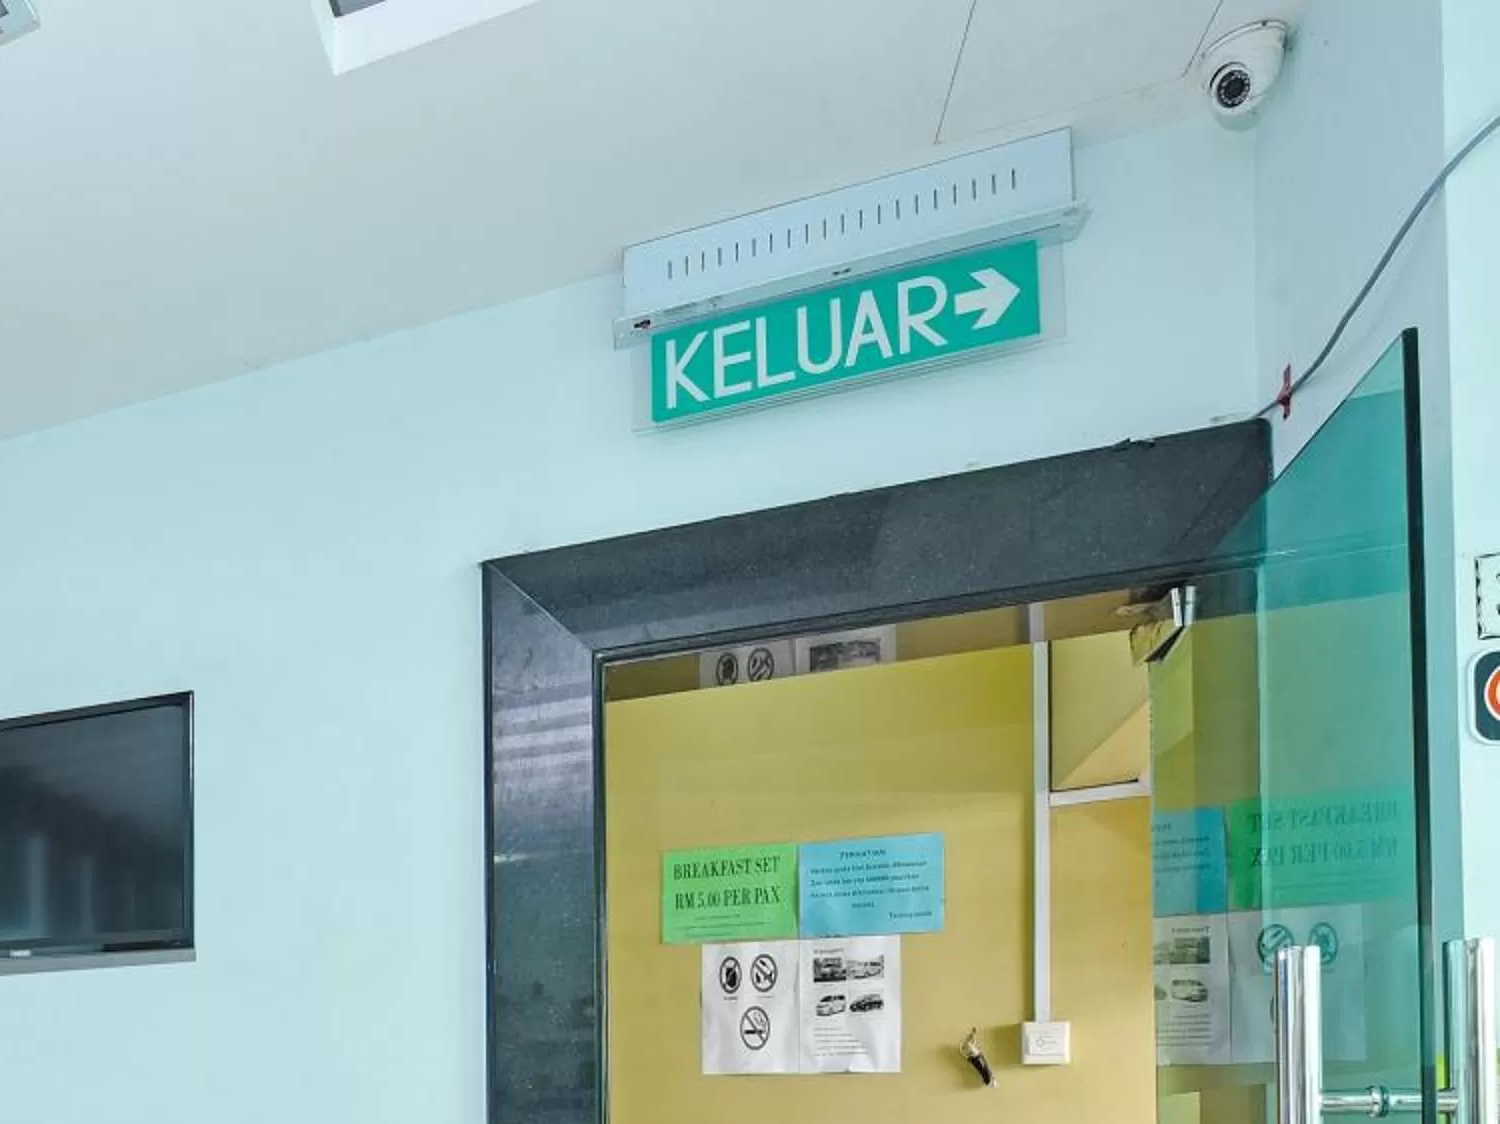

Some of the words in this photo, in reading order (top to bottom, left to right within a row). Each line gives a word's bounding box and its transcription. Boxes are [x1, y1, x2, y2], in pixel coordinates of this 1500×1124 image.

[665, 275, 949, 409] KELUAR
[673, 858, 751, 880] BREAKFAST
[754, 855, 780, 873] SET
[675, 892, 695, 910] RM
[723, 887, 751, 907] PER
[755, 885, 781, 905] PAX
